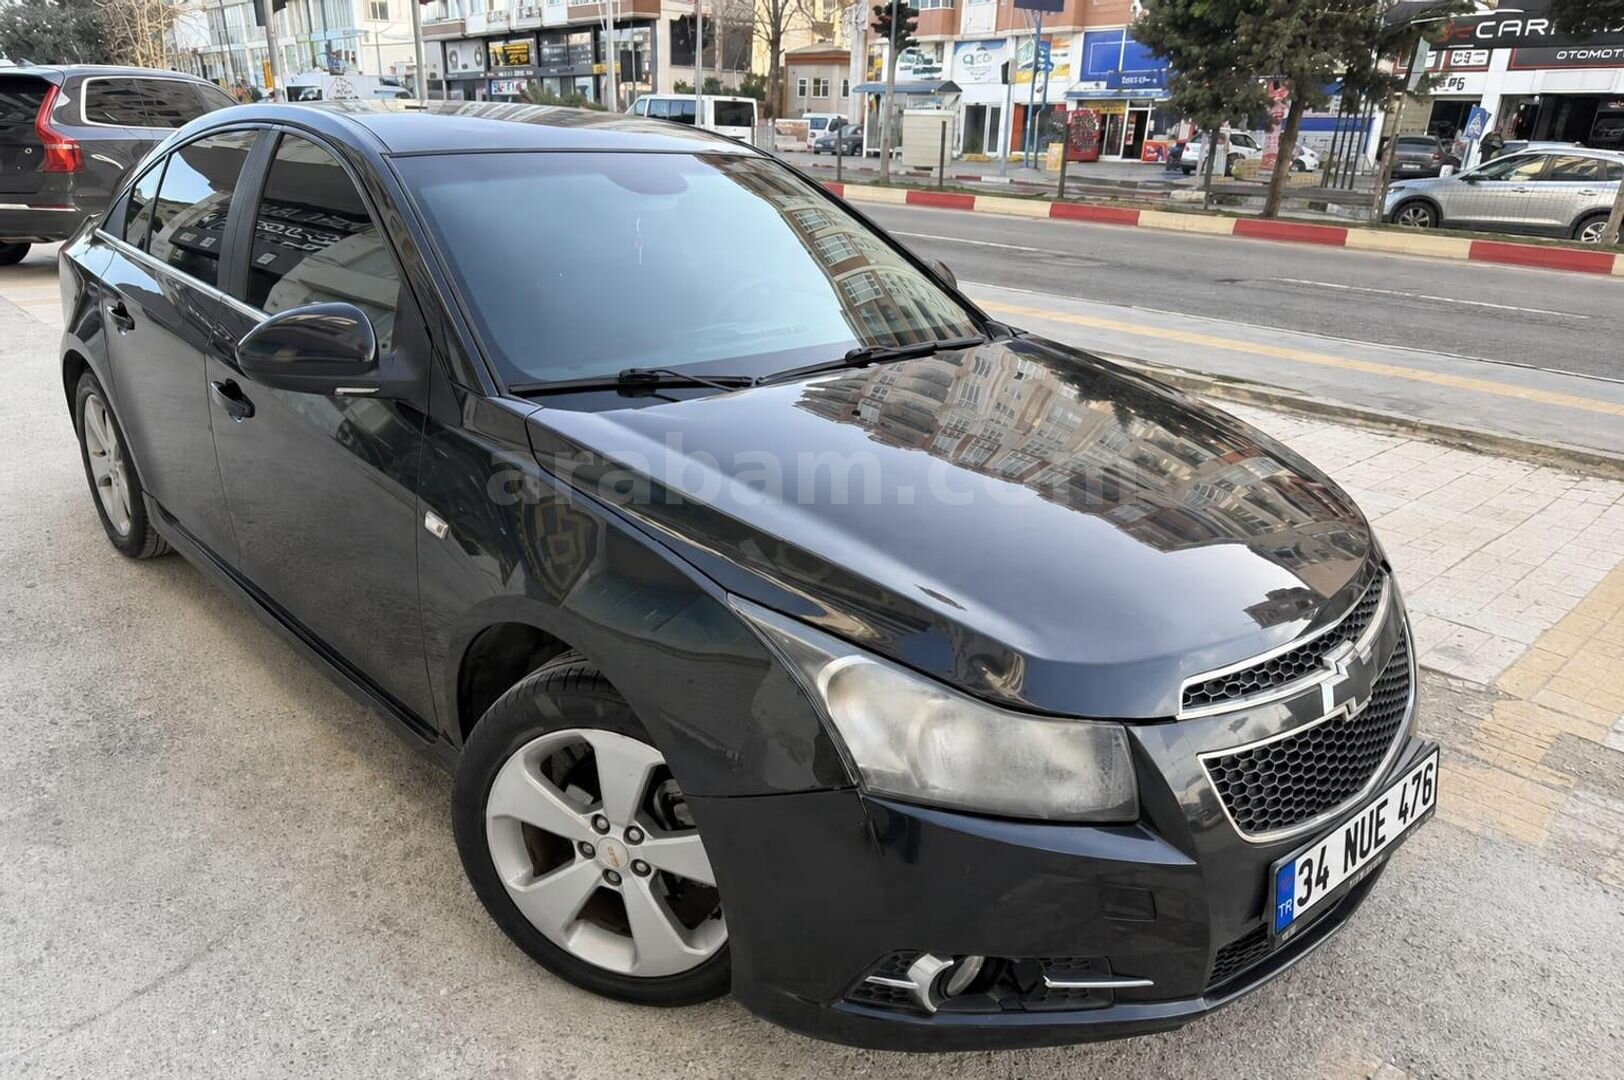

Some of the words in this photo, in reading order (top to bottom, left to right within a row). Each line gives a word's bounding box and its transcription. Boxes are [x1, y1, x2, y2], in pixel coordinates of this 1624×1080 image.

[1556, 49, 1624, 60] OTOMOT
[1296, 845, 1330, 907] 34
[1343, 798, 1389, 874] NUE
[1397, 762, 1434, 825] 476
[1278, 899, 1293, 918] TR
